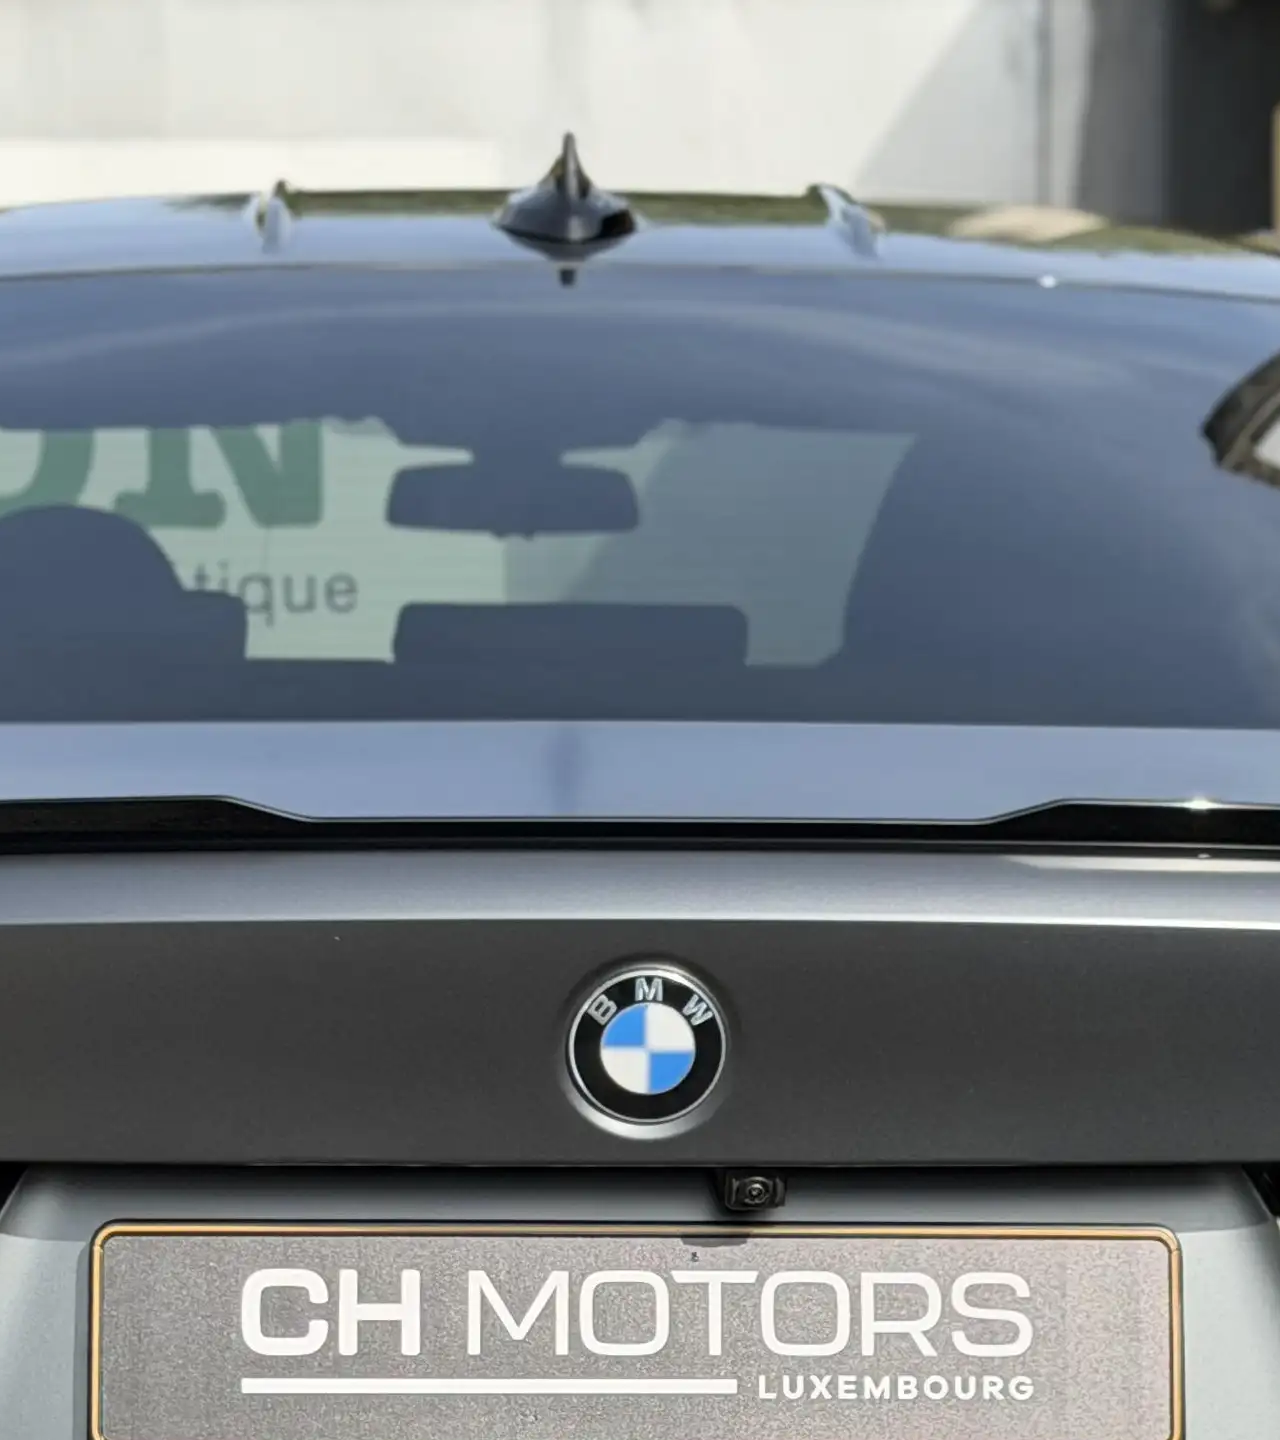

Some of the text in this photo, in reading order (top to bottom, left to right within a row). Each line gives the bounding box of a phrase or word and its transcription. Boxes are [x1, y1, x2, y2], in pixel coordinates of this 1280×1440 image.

[192, 558, 360, 627] tique
[586, 976, 714, 1027] BMW
[241, 1268, 1034, 1358] CH MOTORS
[758, 1374, 1036, 1401] LUXEMBOURG
